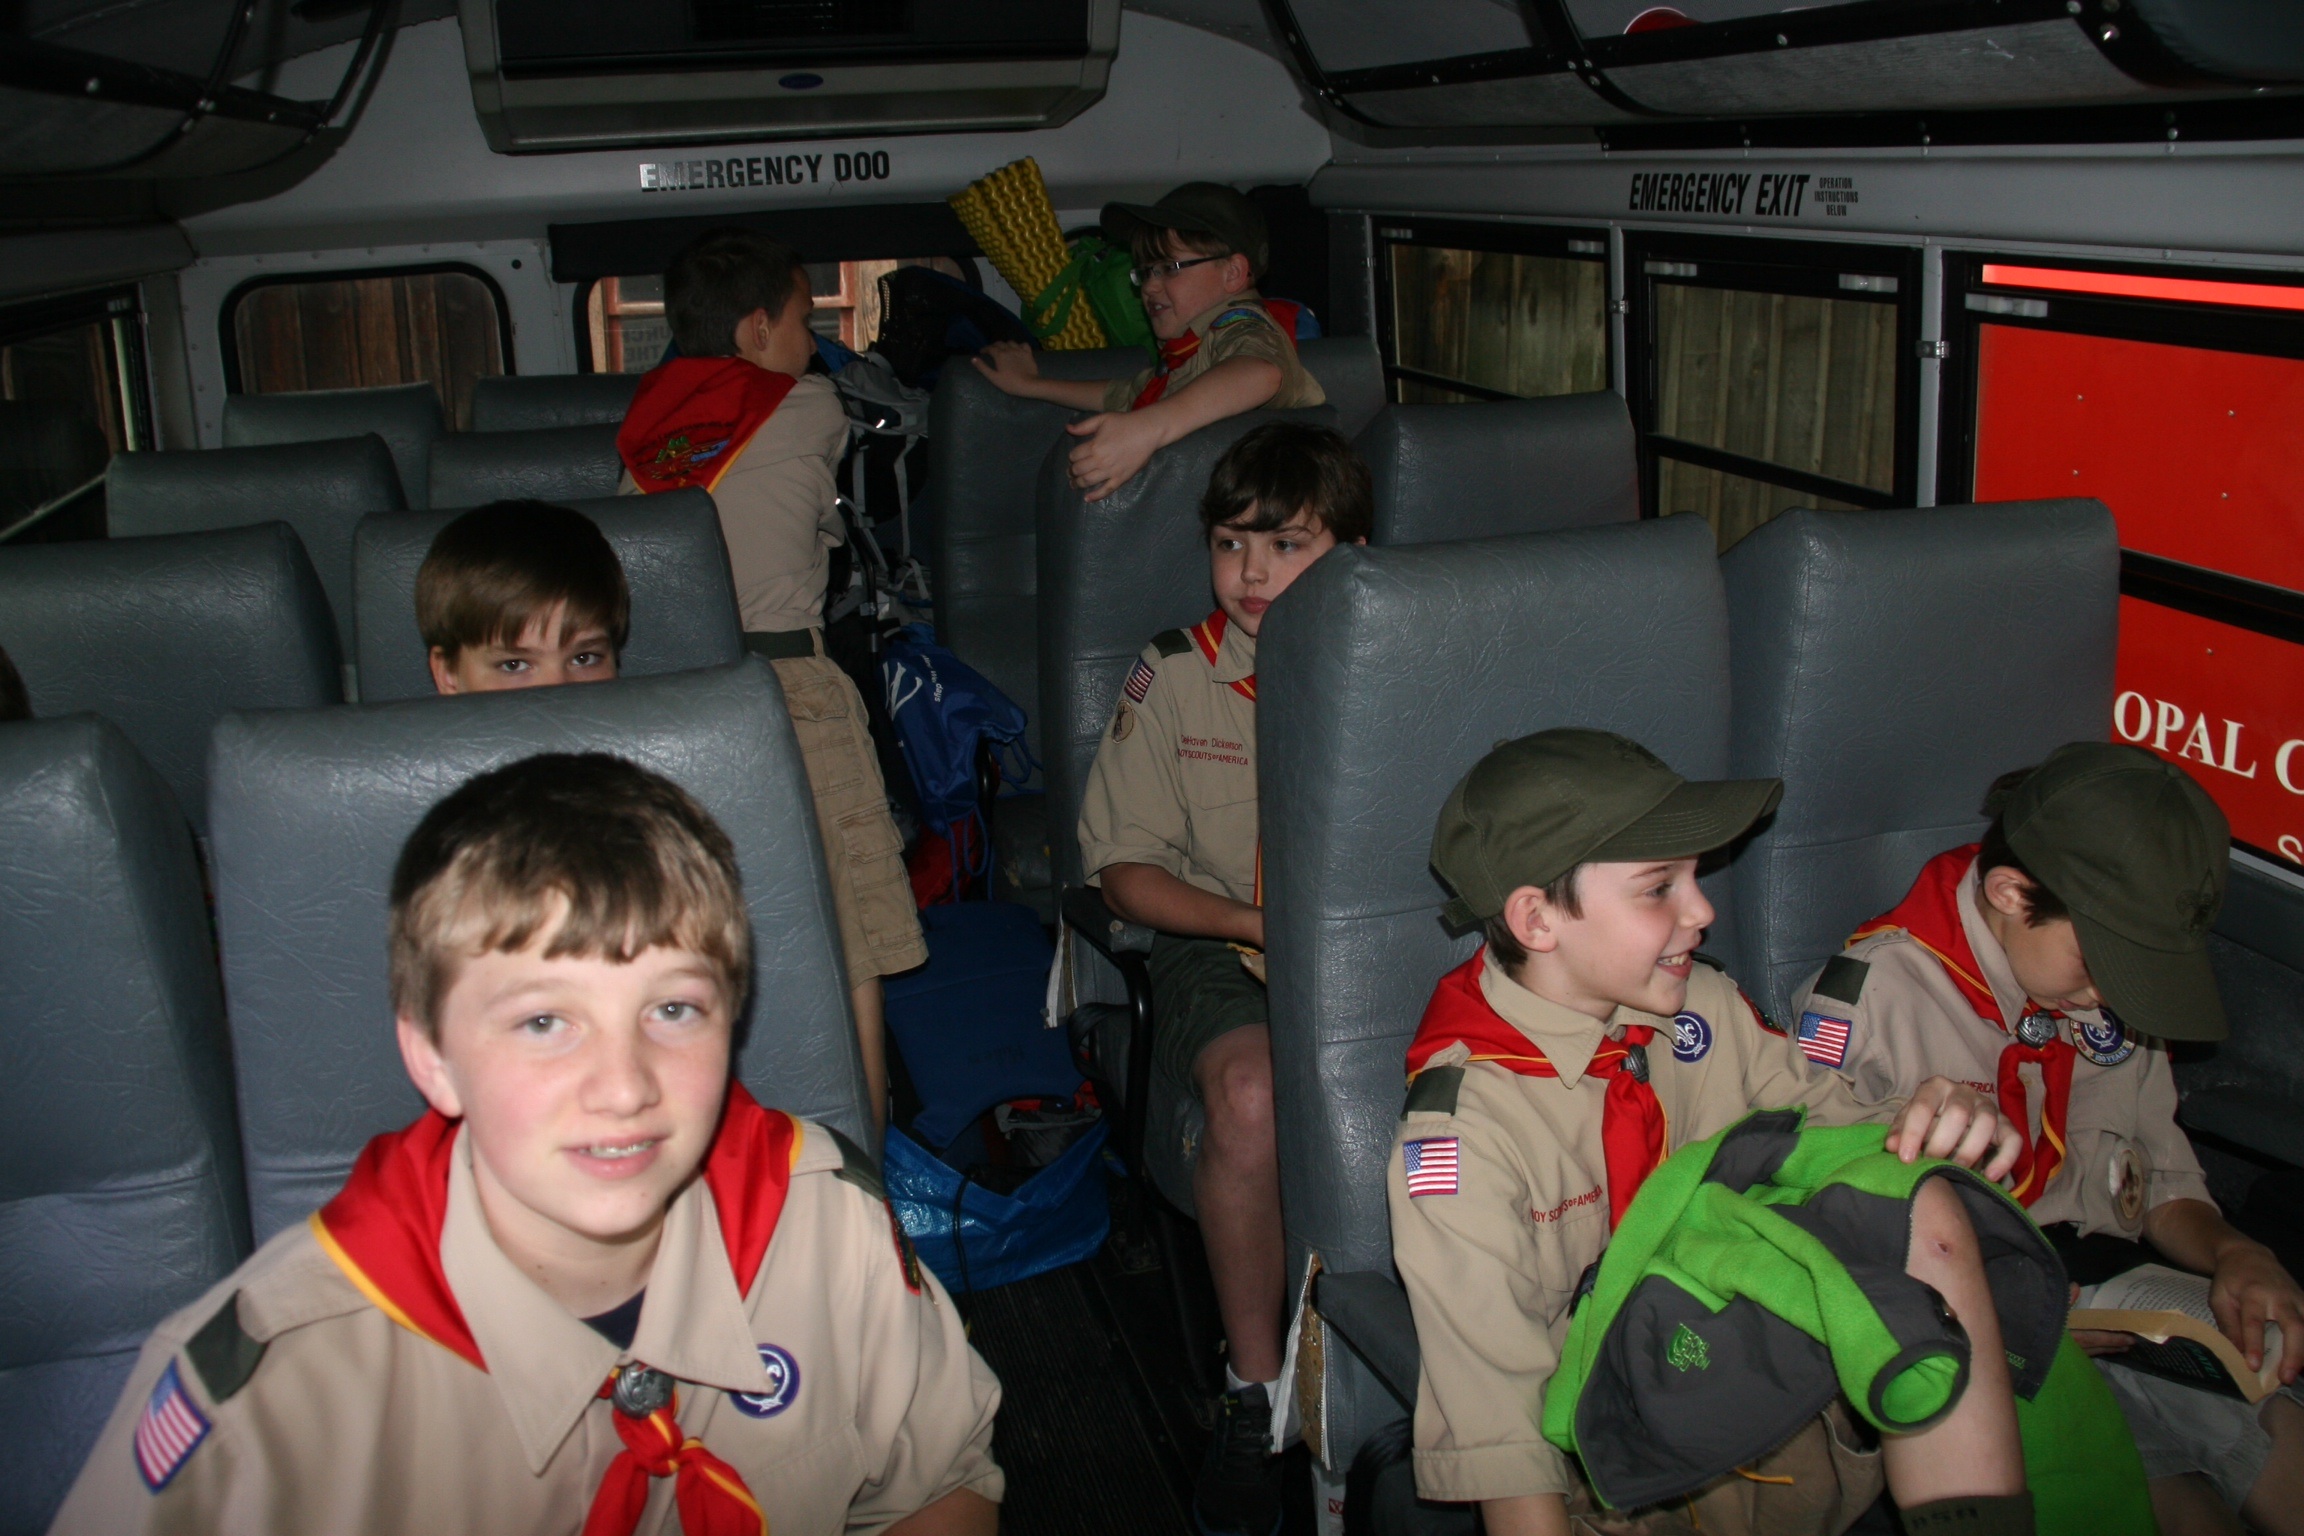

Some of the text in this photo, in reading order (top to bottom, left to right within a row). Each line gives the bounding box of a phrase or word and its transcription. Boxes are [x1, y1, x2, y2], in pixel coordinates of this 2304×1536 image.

[639, 150, 890, 192] EMERGENCY DOO
[1819, 177, 1853, 189] OPERATION
[1629, 173, 1811, 217] EMERGENCY EXIT
[1814, 190, 1859, 203] INSTRUCTIONS
[1826, 204, 1847, 217] BELOW
[2113, 690, 2258, 779] OPAL
[1218, 753, 1249, 766] AMERICA
